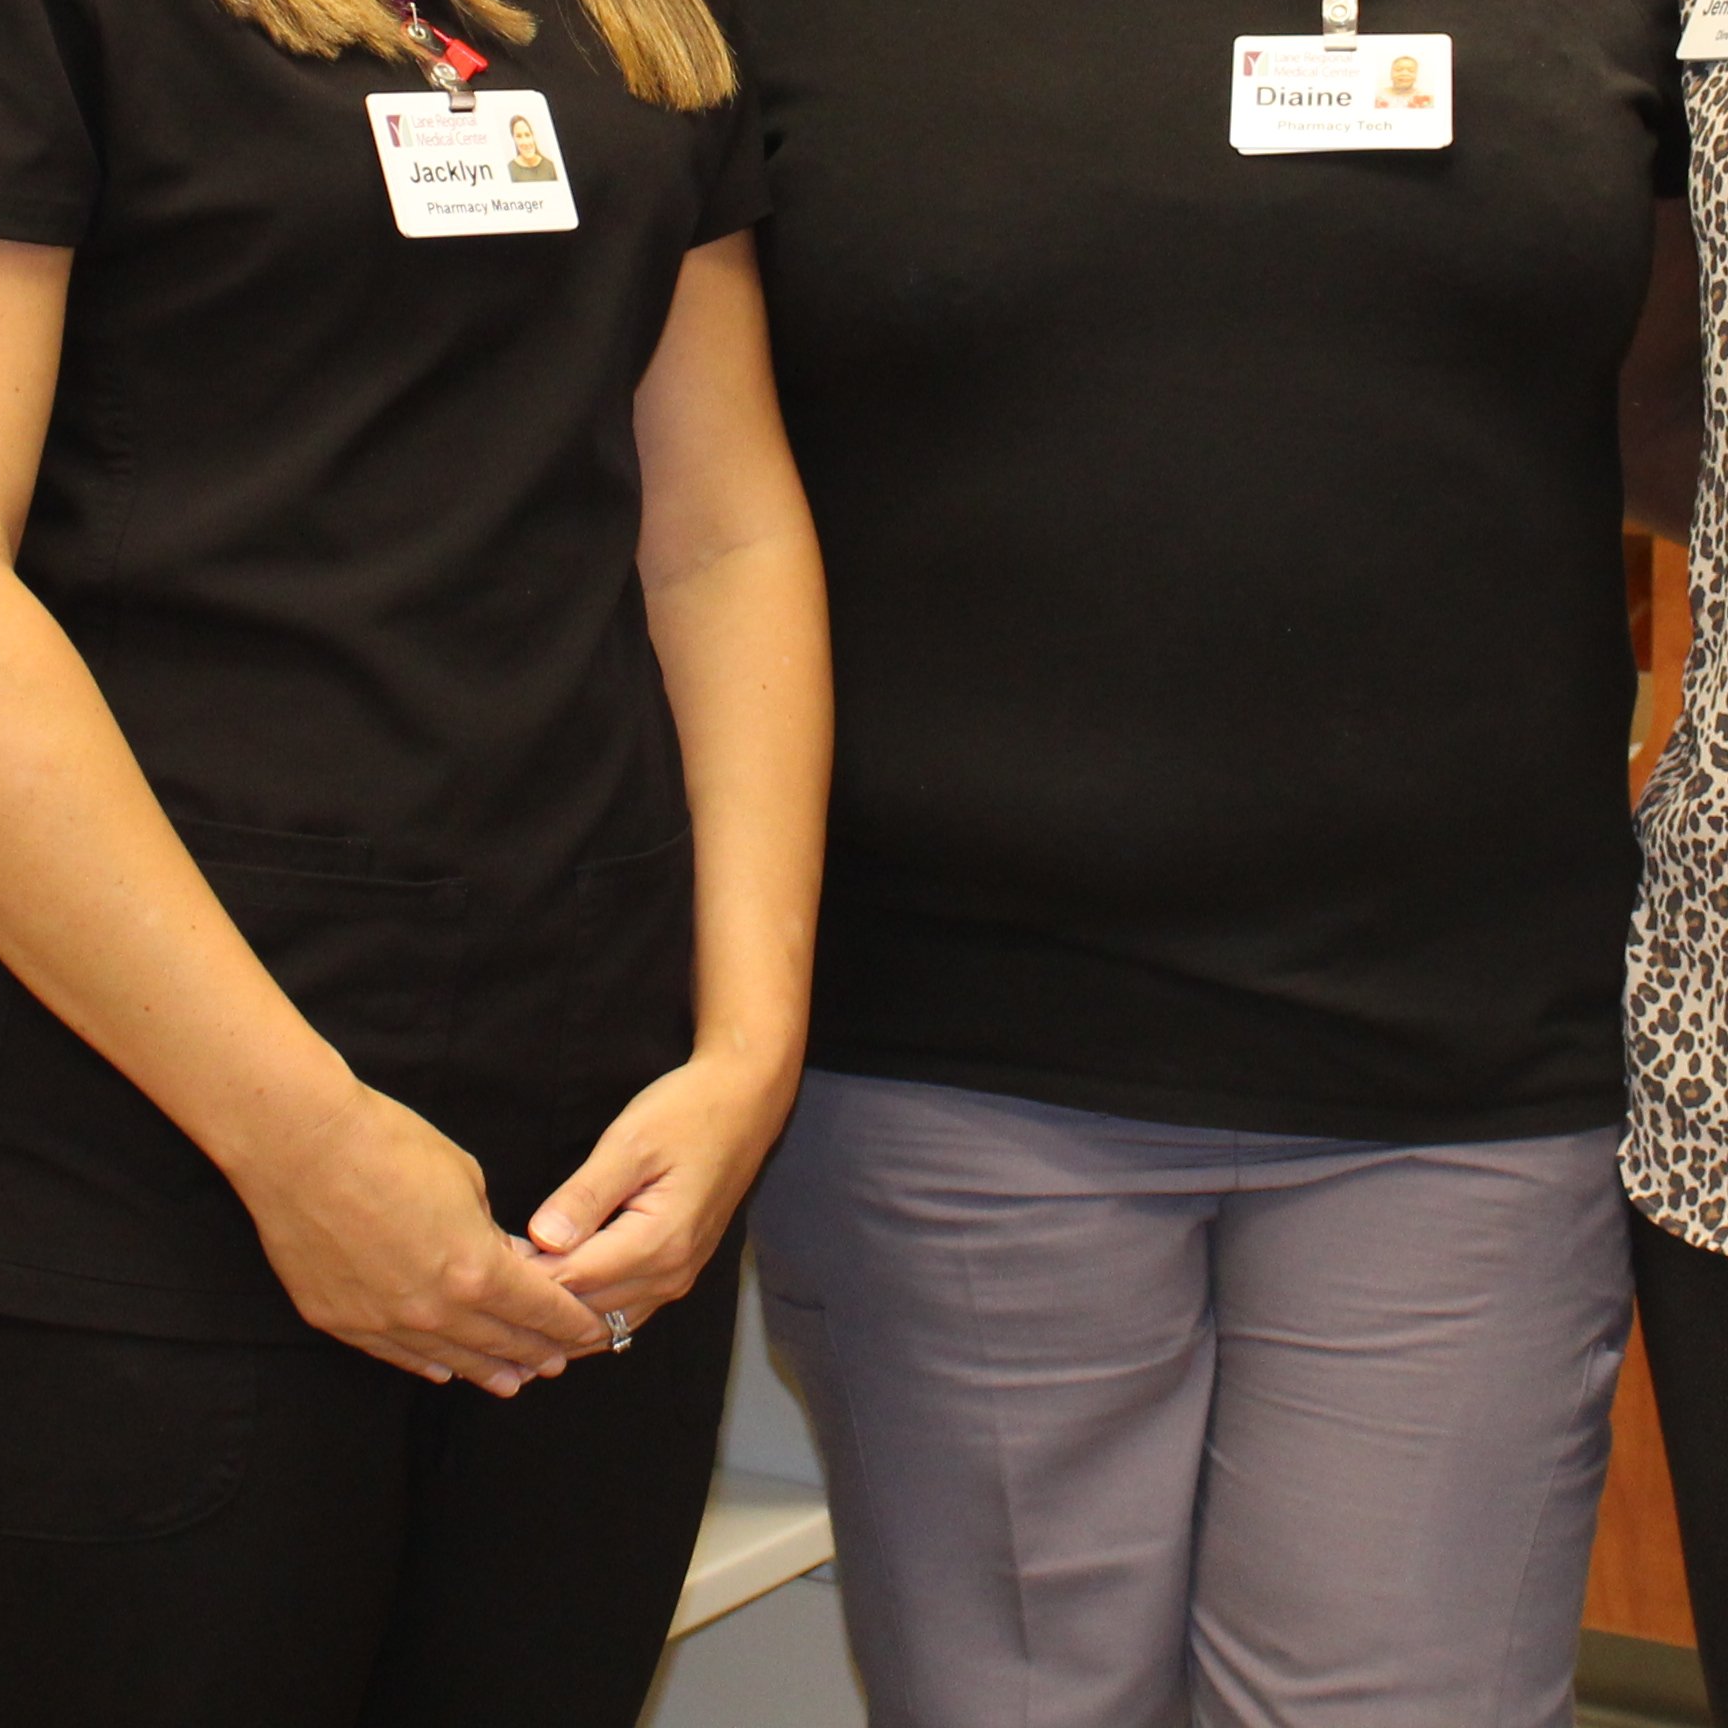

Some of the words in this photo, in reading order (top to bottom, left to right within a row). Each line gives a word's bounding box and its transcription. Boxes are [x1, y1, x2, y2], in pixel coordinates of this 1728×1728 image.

[1256, 86, 1353, 108] Diaine
[1277, 120, 1351, 133] Pharmacy
[1357, 120, 1393, 132] Tech
[409, 160, 494, 187] Jacklyn
[426, 200, 488, 216] Pharmacy
[491, 197, 544, 215] Manager
